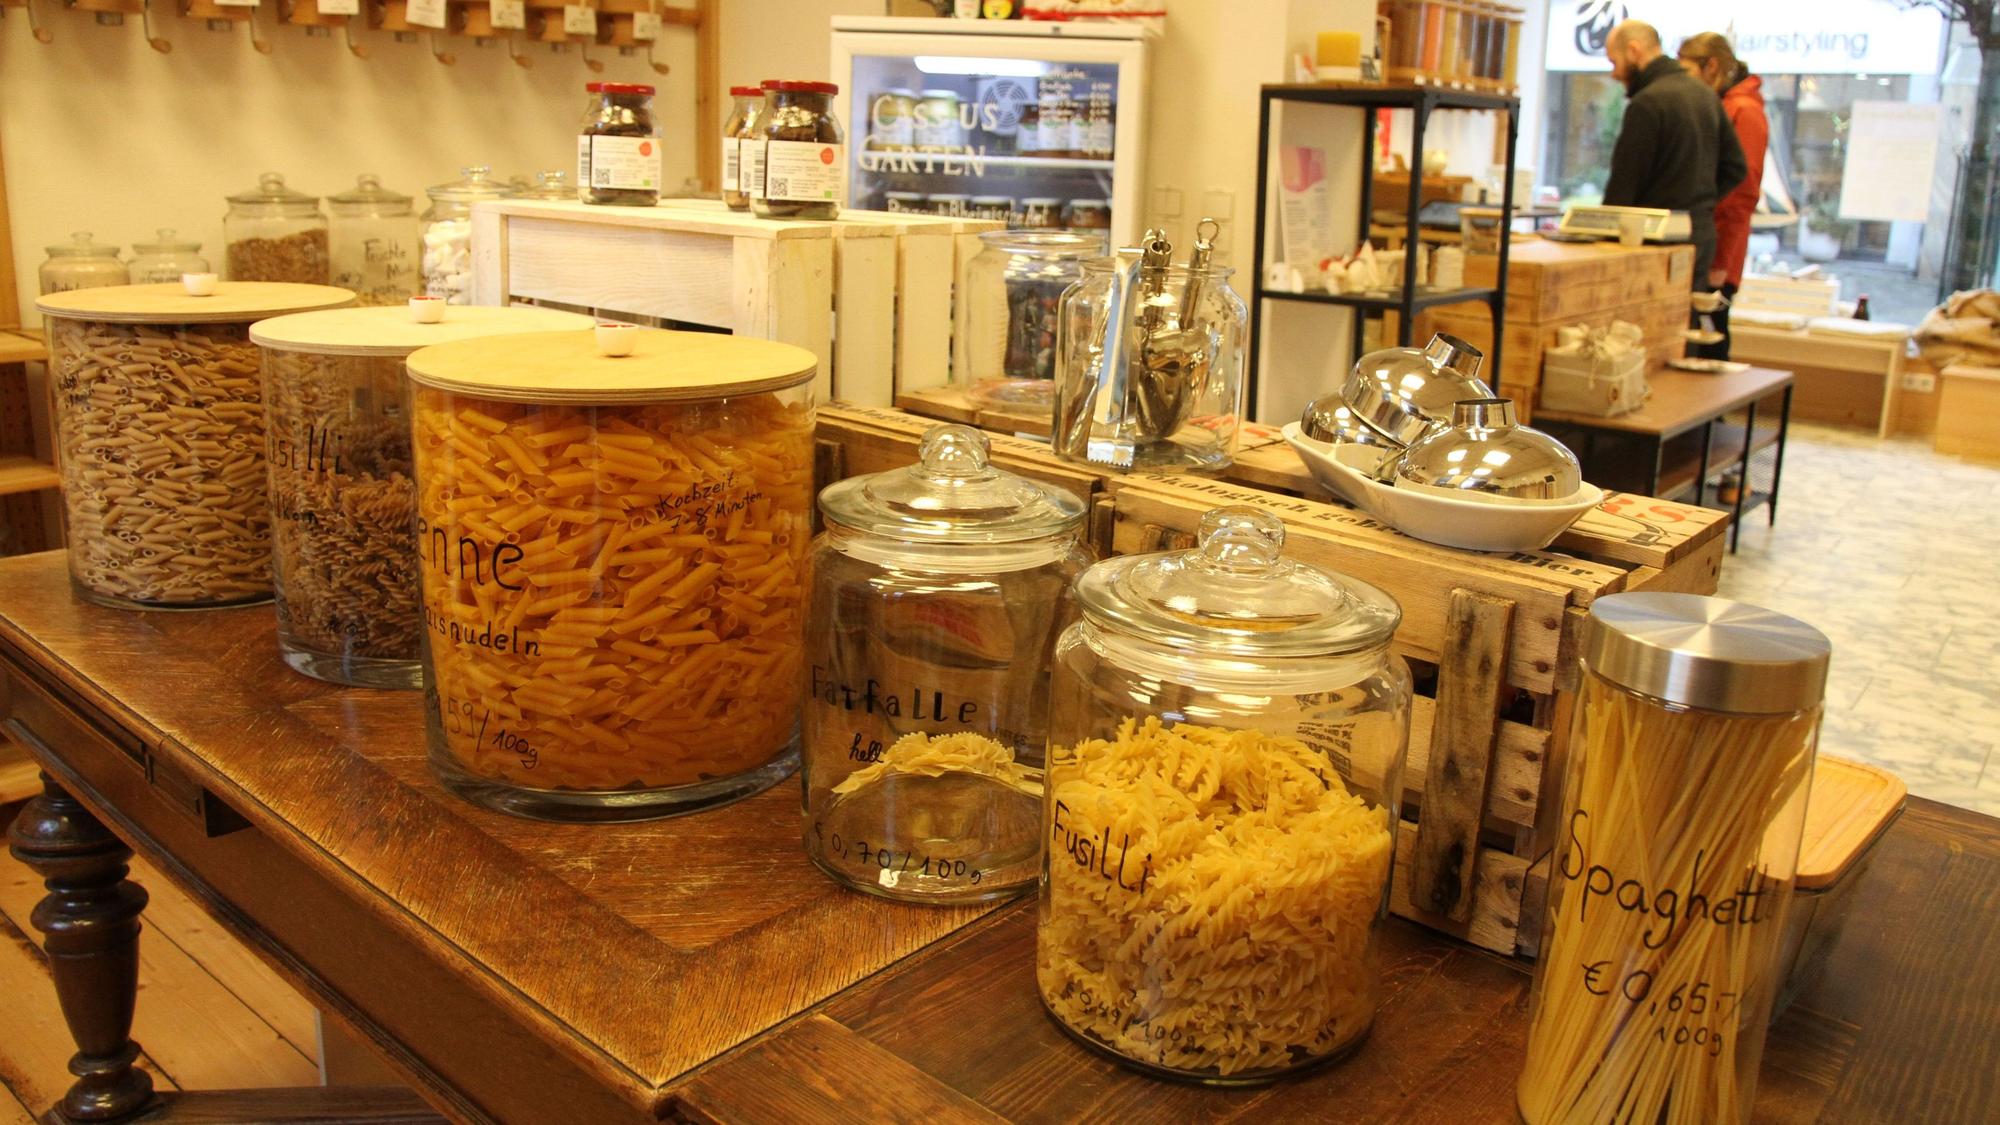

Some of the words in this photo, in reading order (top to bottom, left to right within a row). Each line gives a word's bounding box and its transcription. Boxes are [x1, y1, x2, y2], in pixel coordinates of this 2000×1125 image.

[1734, 29, 1868, 60] airstyling
[857, 134, 987, 178] GARTEN
[267, 424, 346, 474] usilli
[417, 517, 524, 591] enne
[424, 602, 541, 657] aisnudeln
[811, 664, 978, 724] Farfalle
[849, 732, 884, 764] hell
[1053, 799, 1153, 897] Fusilli
[1654, 1025, 1723, 1057] 100g
